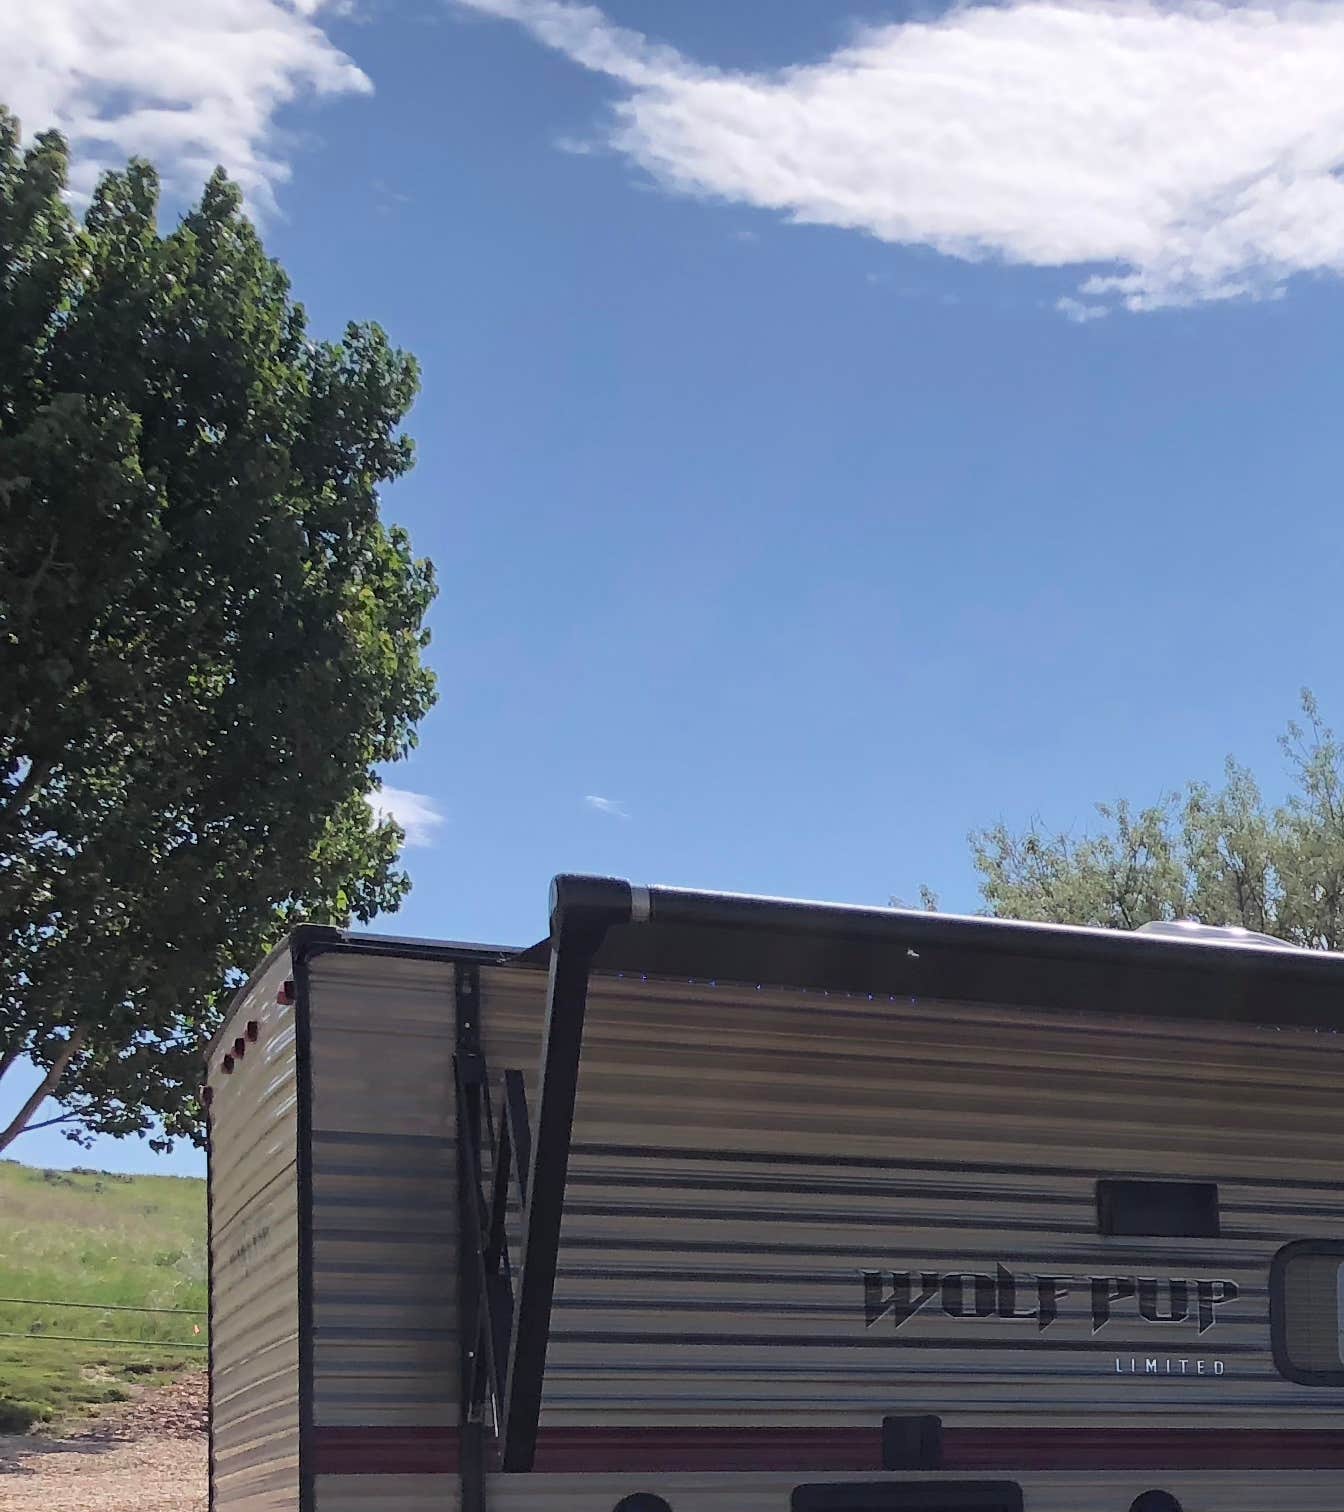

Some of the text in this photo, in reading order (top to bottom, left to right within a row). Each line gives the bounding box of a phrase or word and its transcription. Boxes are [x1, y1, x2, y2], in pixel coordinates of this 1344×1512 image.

[860, 1261, 1241, 1337] WOLF PUP
[1114, 1357, 1226, 1377] LIMITED
